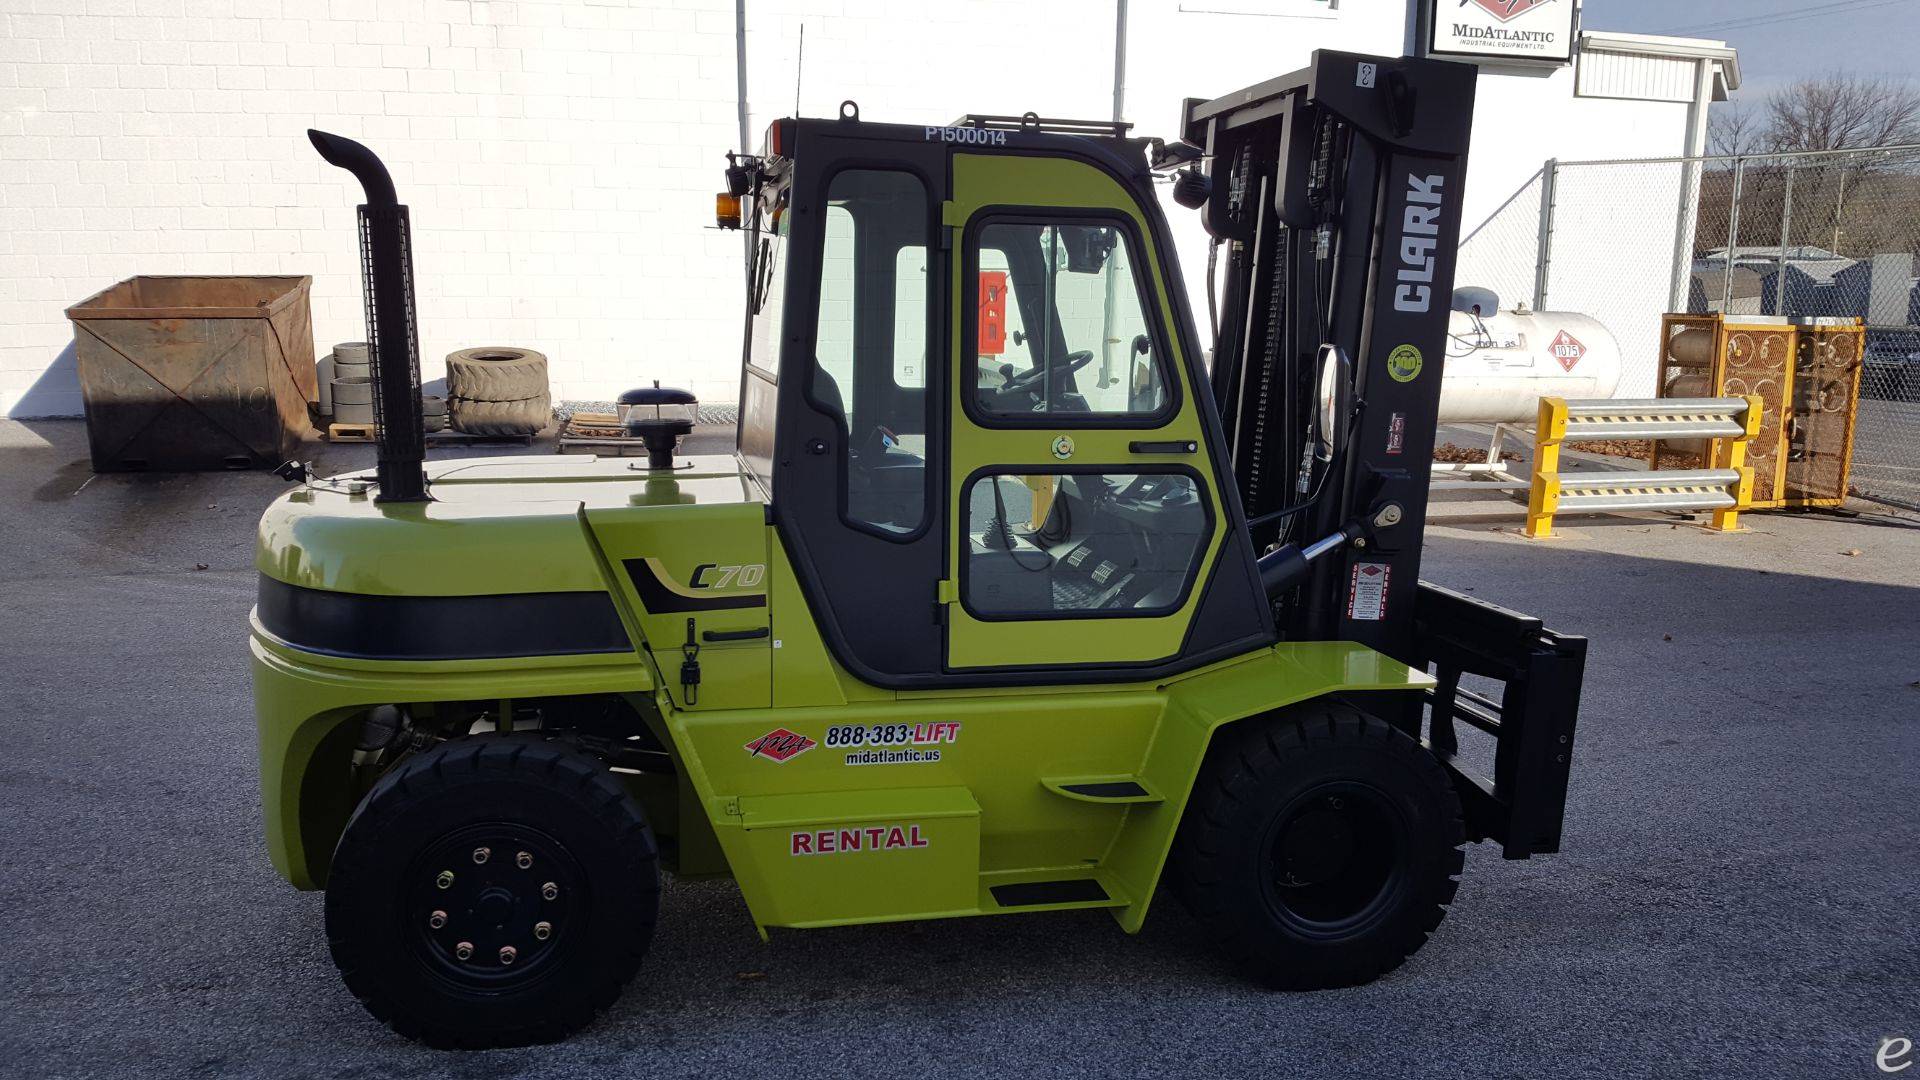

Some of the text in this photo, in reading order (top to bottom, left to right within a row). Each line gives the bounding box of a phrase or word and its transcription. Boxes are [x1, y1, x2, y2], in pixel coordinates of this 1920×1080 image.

[1459, 39, 1496, 47] INDUSTRIAL
[1498, 41, 1533, 49] EQUIPMENT
[925, 127, 1007, 145] P1500014
[1393, 173, 1444, 313] CLARK
[1556, 346, 1578, 357] 1075
[689, 563, 766, 589] C70
[1348, 565, 1358, 616] SERVICE
[1380, 566, 1391, 617] RENTALS
[846, 749, 940, 765] midatlantic.us
[792, 826, 928, 854] RENTAL
